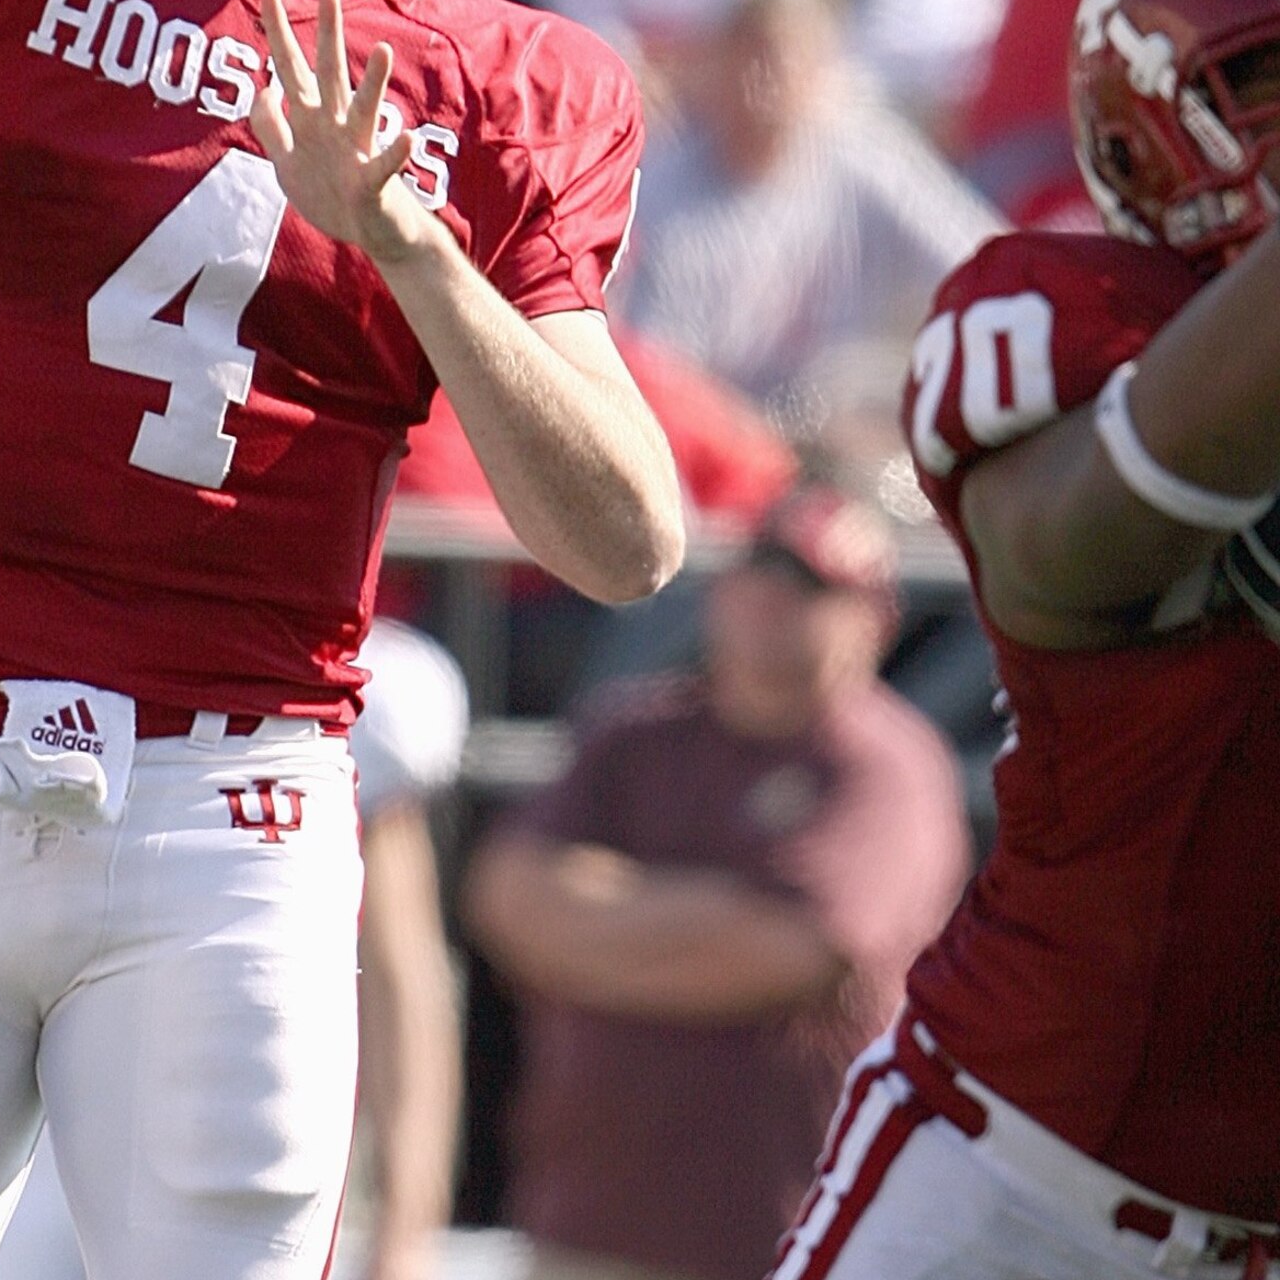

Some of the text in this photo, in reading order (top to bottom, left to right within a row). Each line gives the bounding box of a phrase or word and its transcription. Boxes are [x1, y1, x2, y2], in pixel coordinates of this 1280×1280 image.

[87, 148, 287, 488] 4
[911, 290, 1058, 478] 70
[31, 726, 105, 755] adidas
